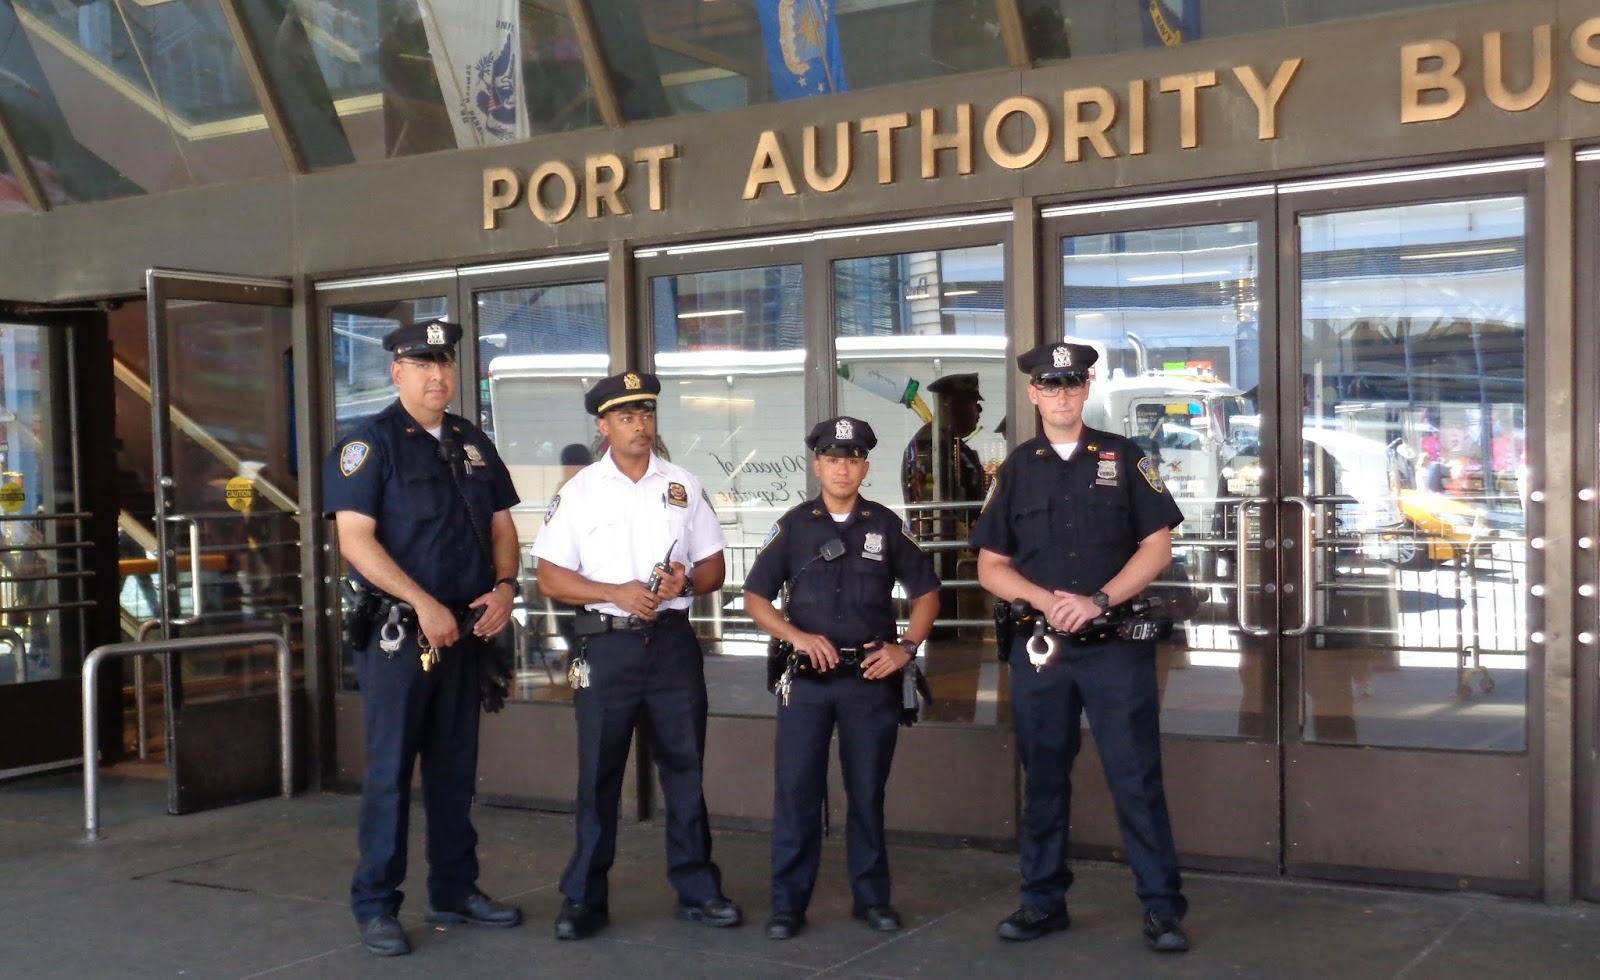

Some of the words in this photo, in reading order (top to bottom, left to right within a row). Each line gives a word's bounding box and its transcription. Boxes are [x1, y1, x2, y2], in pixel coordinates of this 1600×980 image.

[483, 143, 677, 231] PORT
[742, 58, 1303, 200] AUTHORITY
[226, 490, 252, 498] CAUTION
